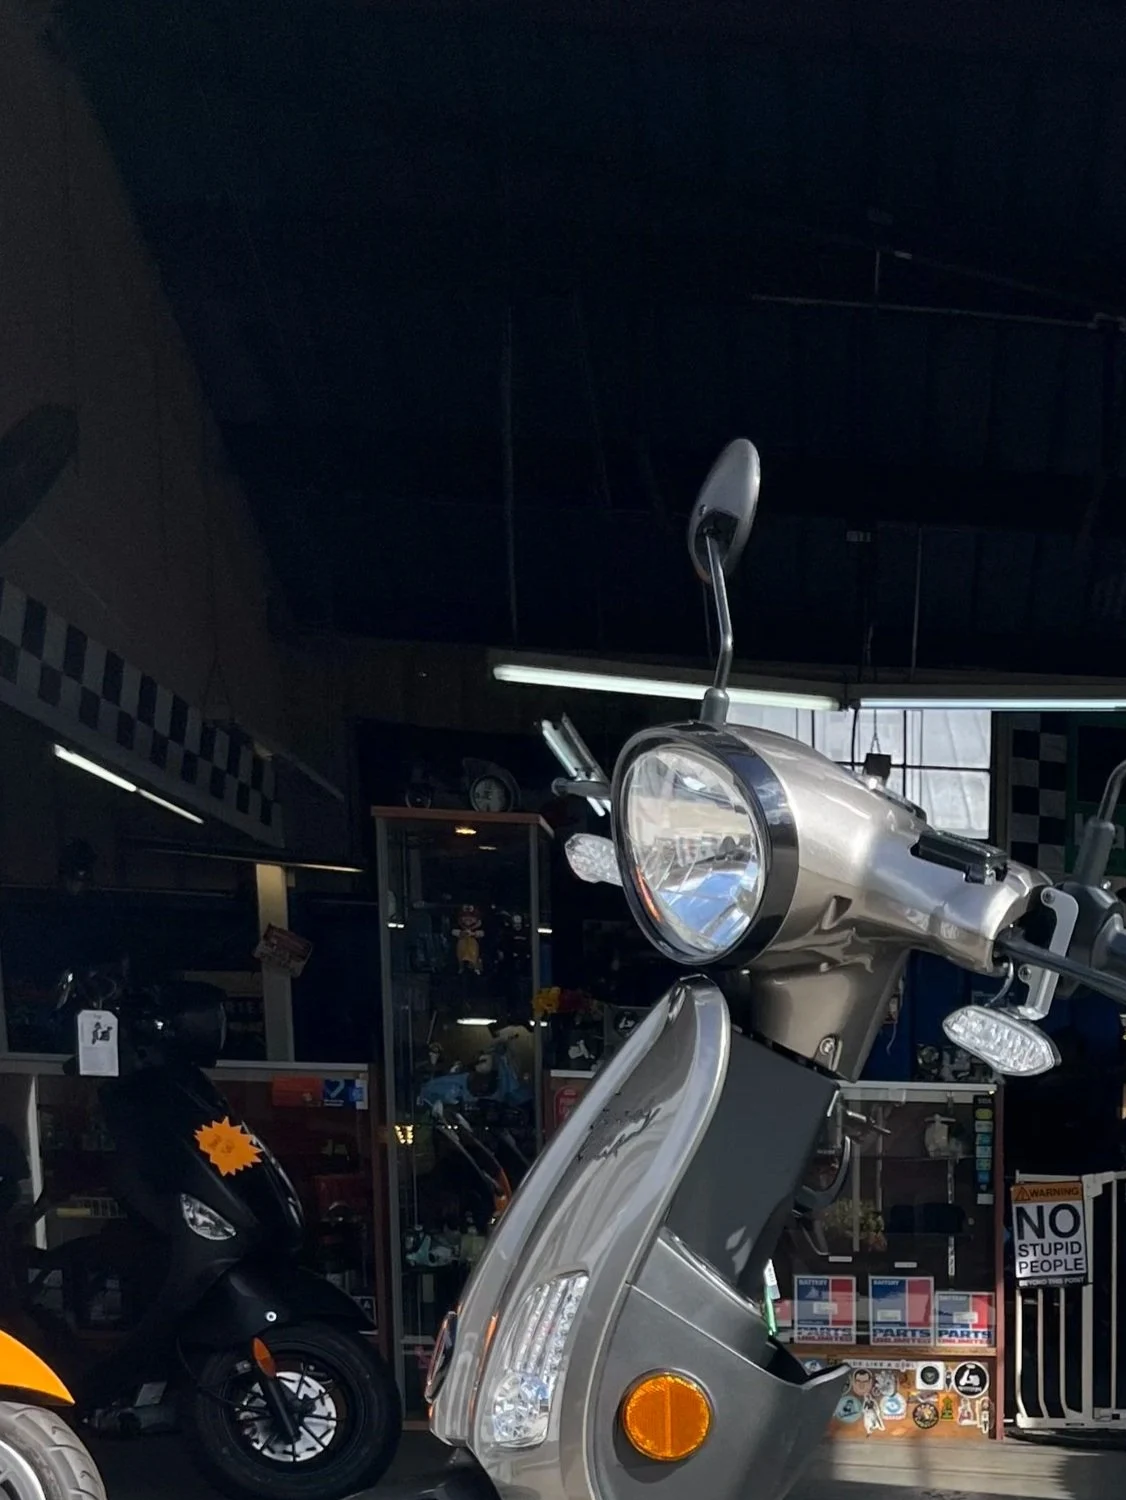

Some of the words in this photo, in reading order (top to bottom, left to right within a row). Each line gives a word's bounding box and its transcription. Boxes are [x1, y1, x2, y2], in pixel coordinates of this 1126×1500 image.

[1030, 1187, 1079, 1198] WARNING
[1016, 1203, 1081, 1240] NO
[1018, 1241, 1082, 1257] STUPID
[1019, 1258, 1084, 1274] PEOPLE
[1019, 1278, 1047, 1287] BEYOND
[1049, 1278, 1064, 1286] THIS
[1065, 1276, 1084, 1285] POINT
[797, 1327, 851, 1336] PARTS
[872, 1329, 931, 1338] PARTS
[938, 1330, 992, 1339] PARTS
